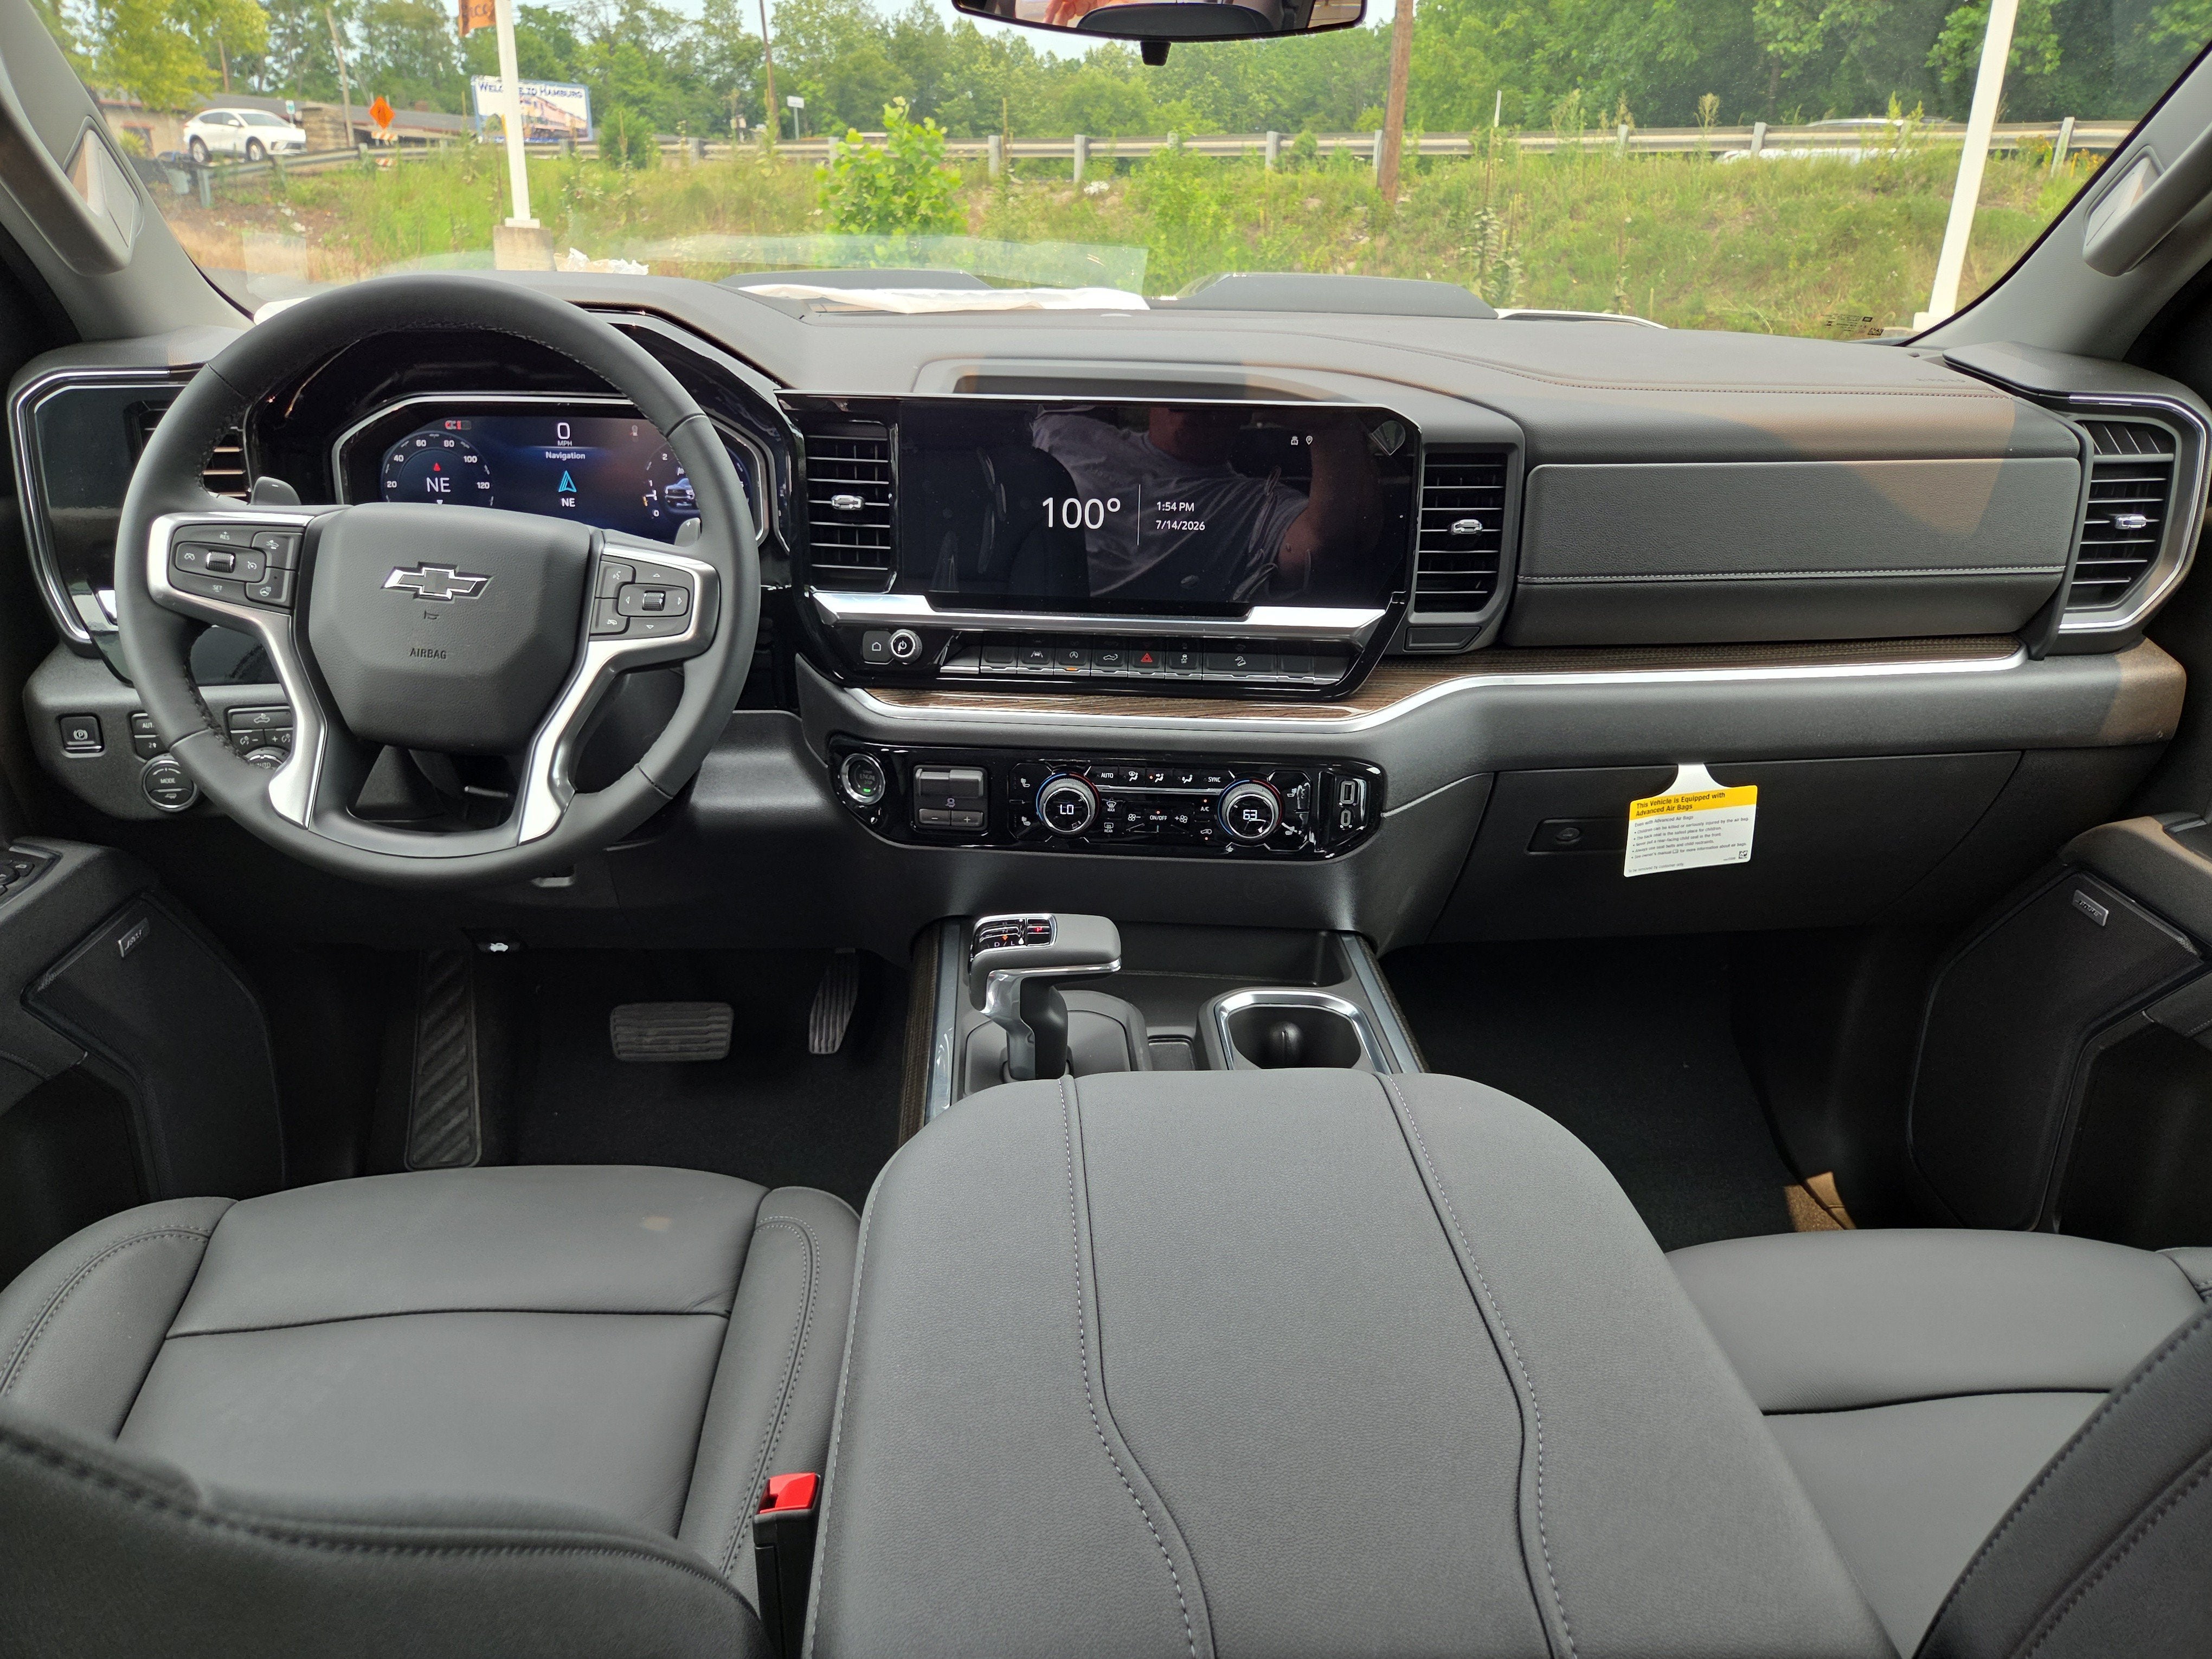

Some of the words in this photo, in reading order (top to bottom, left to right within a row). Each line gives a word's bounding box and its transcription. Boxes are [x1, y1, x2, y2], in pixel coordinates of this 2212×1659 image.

[557, 422, 570, 440] 0
[545, 451, 586, 460] Navigation
[426, 477, 451, 492] NE
[561, 498, 576, 507] NE
[1156, 501, 1177, 511] 1:54
[1179, 502, 1194, 512] PM
[1042, 497, 1121, 529] 100°
[1155, 520, 1205, 531] 7/14/2026
[410, 648, 447, 659] AIRBAG
[1650, 798, 1672, 806] Vehicle
[1681, 794, 1710, 802] Equipped
[1060, 804, 1074, 815] LO
[1243, 809, 1258, 820] 63
[1636, 806, 1664, 816] Advanced
